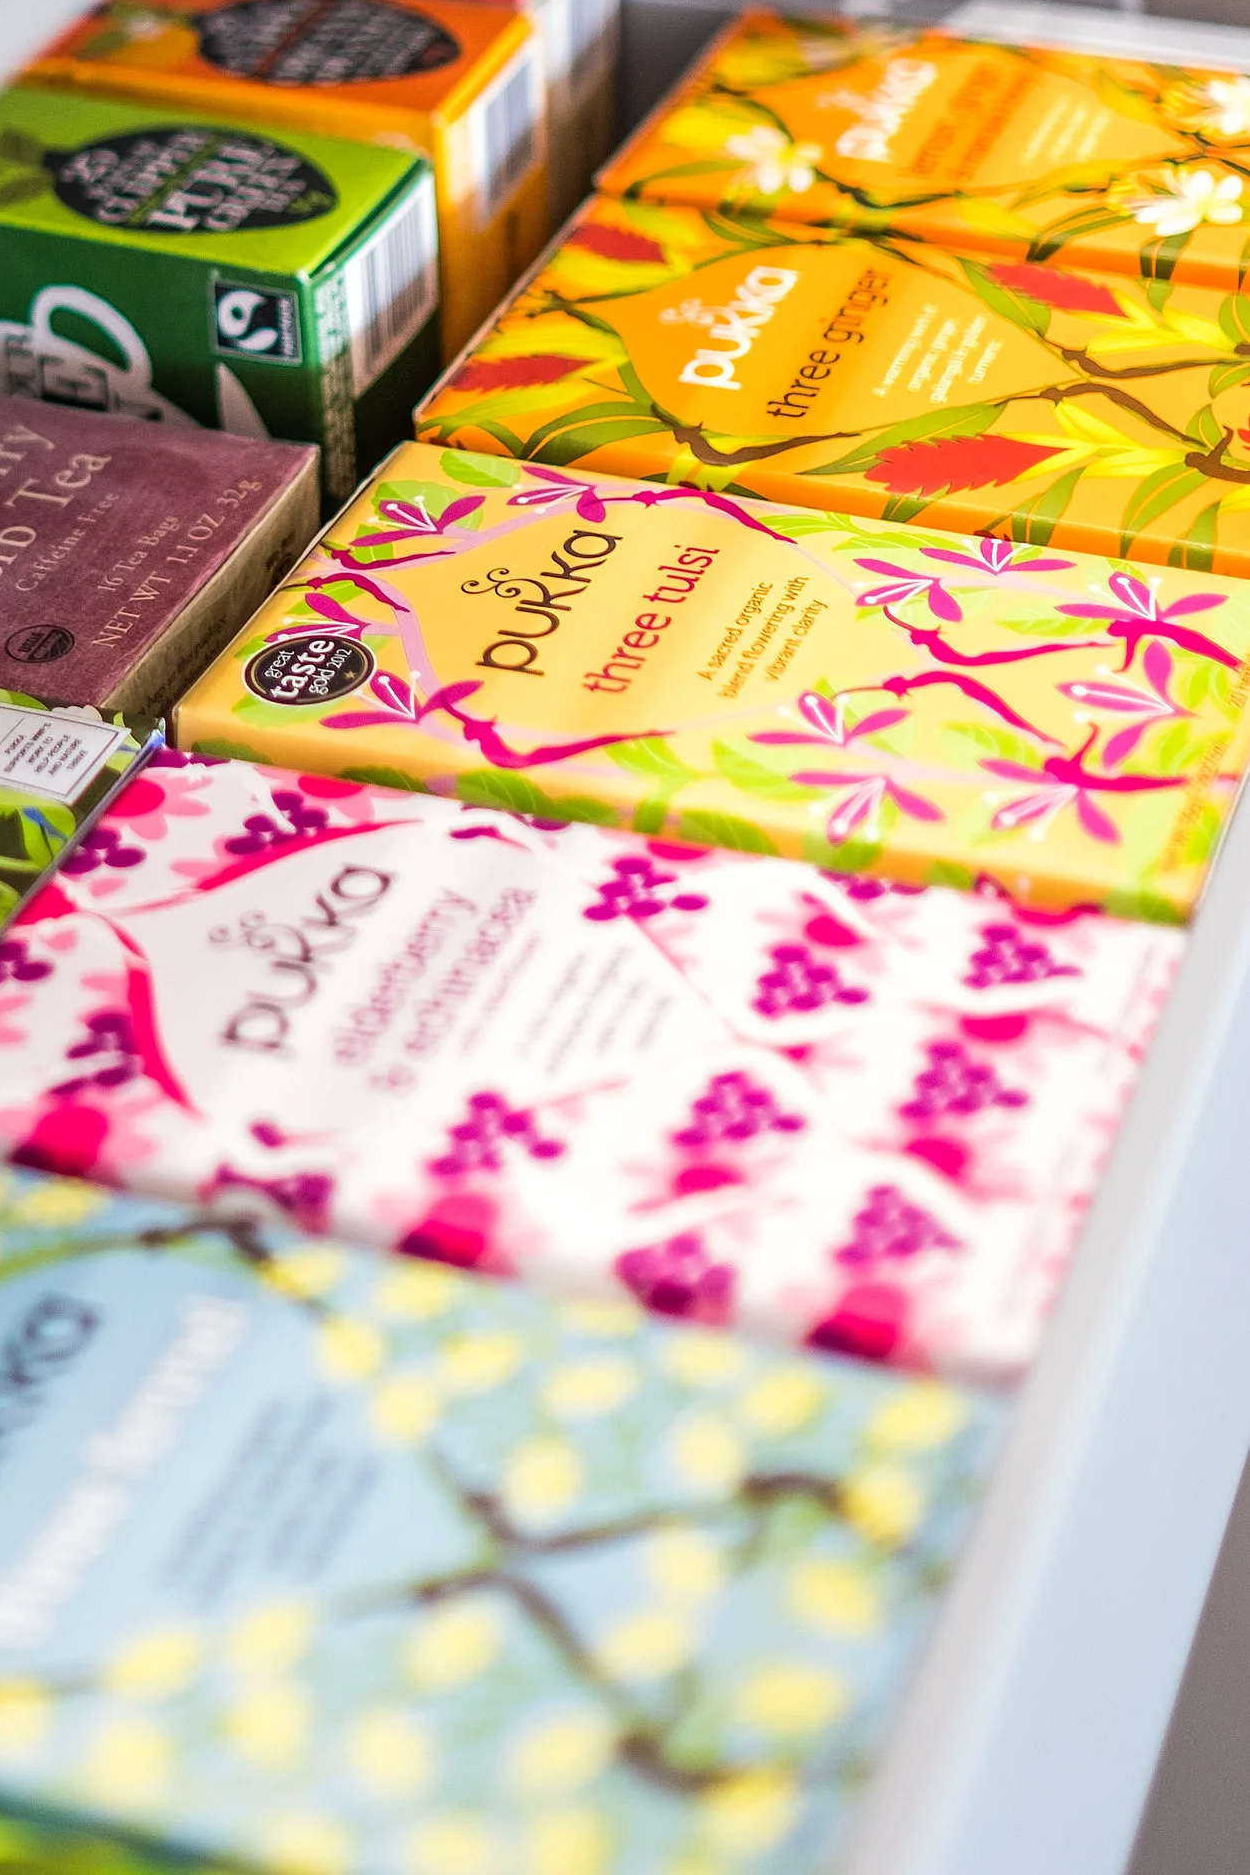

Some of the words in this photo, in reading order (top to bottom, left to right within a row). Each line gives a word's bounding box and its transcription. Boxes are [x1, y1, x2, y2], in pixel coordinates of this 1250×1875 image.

[679, 265, 803, 391] pukka
[766, 343, 841, 421] three
[823, 266, 896, 346] ginger
[3, 451, 112, 509] Tea
[14, 526, 87, 592] Caffeine
[91, 606, 142, 649] NET
[129, 571, 173, 603] WT
[166, 544, 199, 565] 1.1
[187, 513, 226, 541] OZ
[216, 479, 263, 510] 32g
[97, 575, 124, 592] 16
[113, 548, 148, 571] Tea
[137, 515, 180, 546] Bags
[473, 528, 623, 676] pukka
[264, 650, 295, 679] great
[582, 609, 672, 695] three
[649, 543, 720, 609] tulsi
[696, 670, 718, 681] A
[707, 627, 744, 669] sacred
[735, 582, 773, 626] organic
[717, 660, 756, 699] blend
[741, 602, 795, 660] flowering
[781, 576, 810, 601] with
[765, 637, 802, 681] vibrant
[791, 599, 829, 638] clarity
[270, 640, 334, 698] taste
[309, 668, 335, 695] gold
[327, 648, 352, 669] 2012
[219, 862, 396, 1060] pukka
